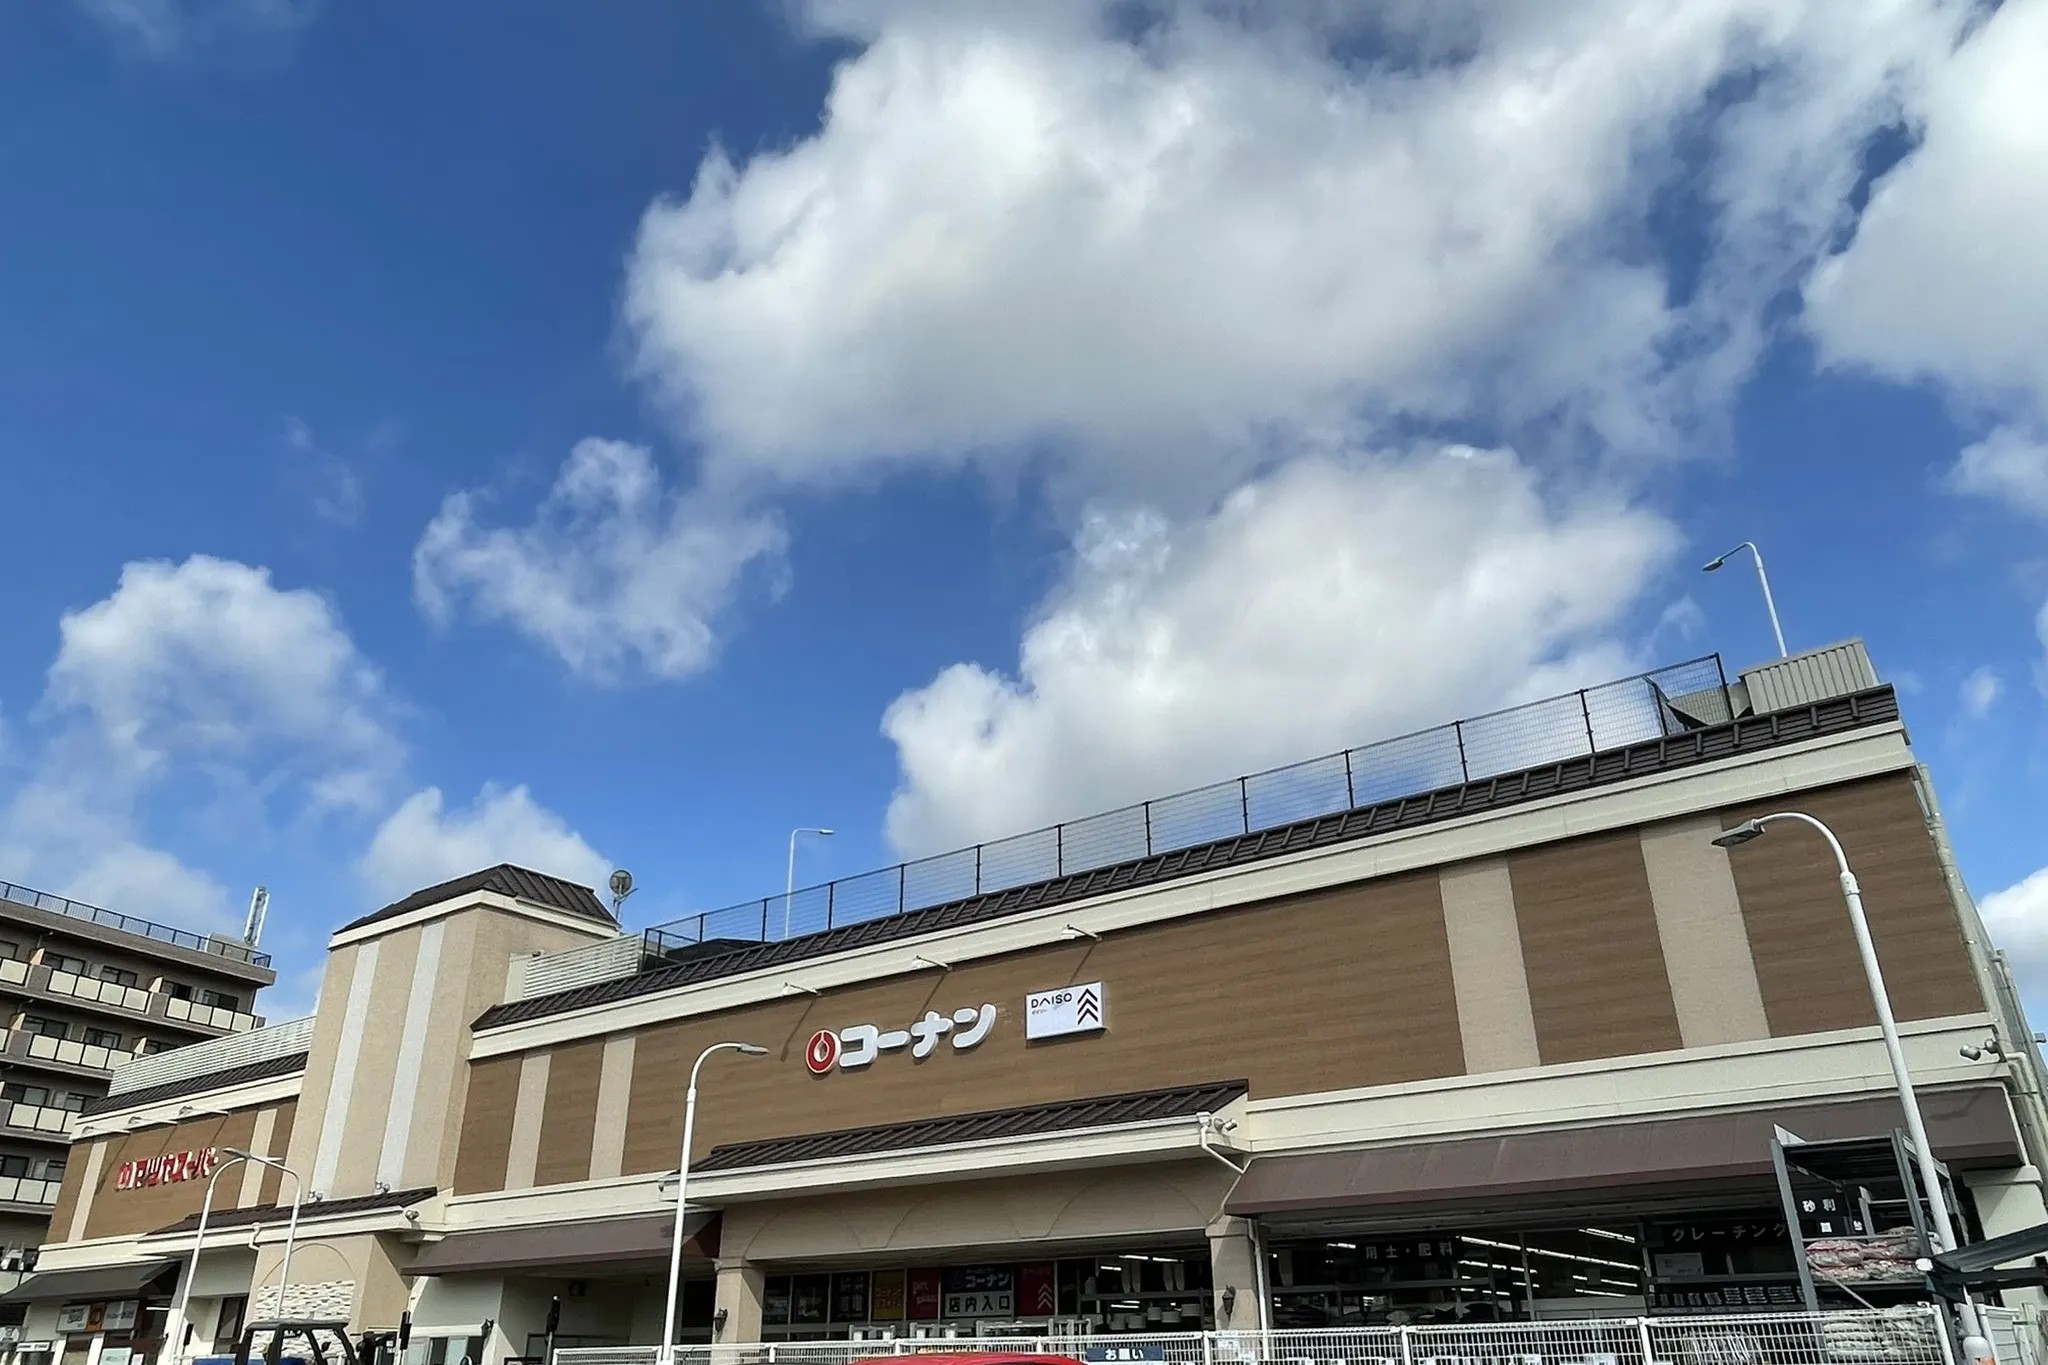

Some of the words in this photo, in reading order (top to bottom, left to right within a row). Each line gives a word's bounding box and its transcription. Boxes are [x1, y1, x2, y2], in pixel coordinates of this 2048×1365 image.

[1031, 993, 1072, 1008] DAISO
[839, 1003, 998, 1067] コーナン
[965, 1273, 1010, 1288] コーナン
[949, 1294, 1010, 1312] 店内入口
